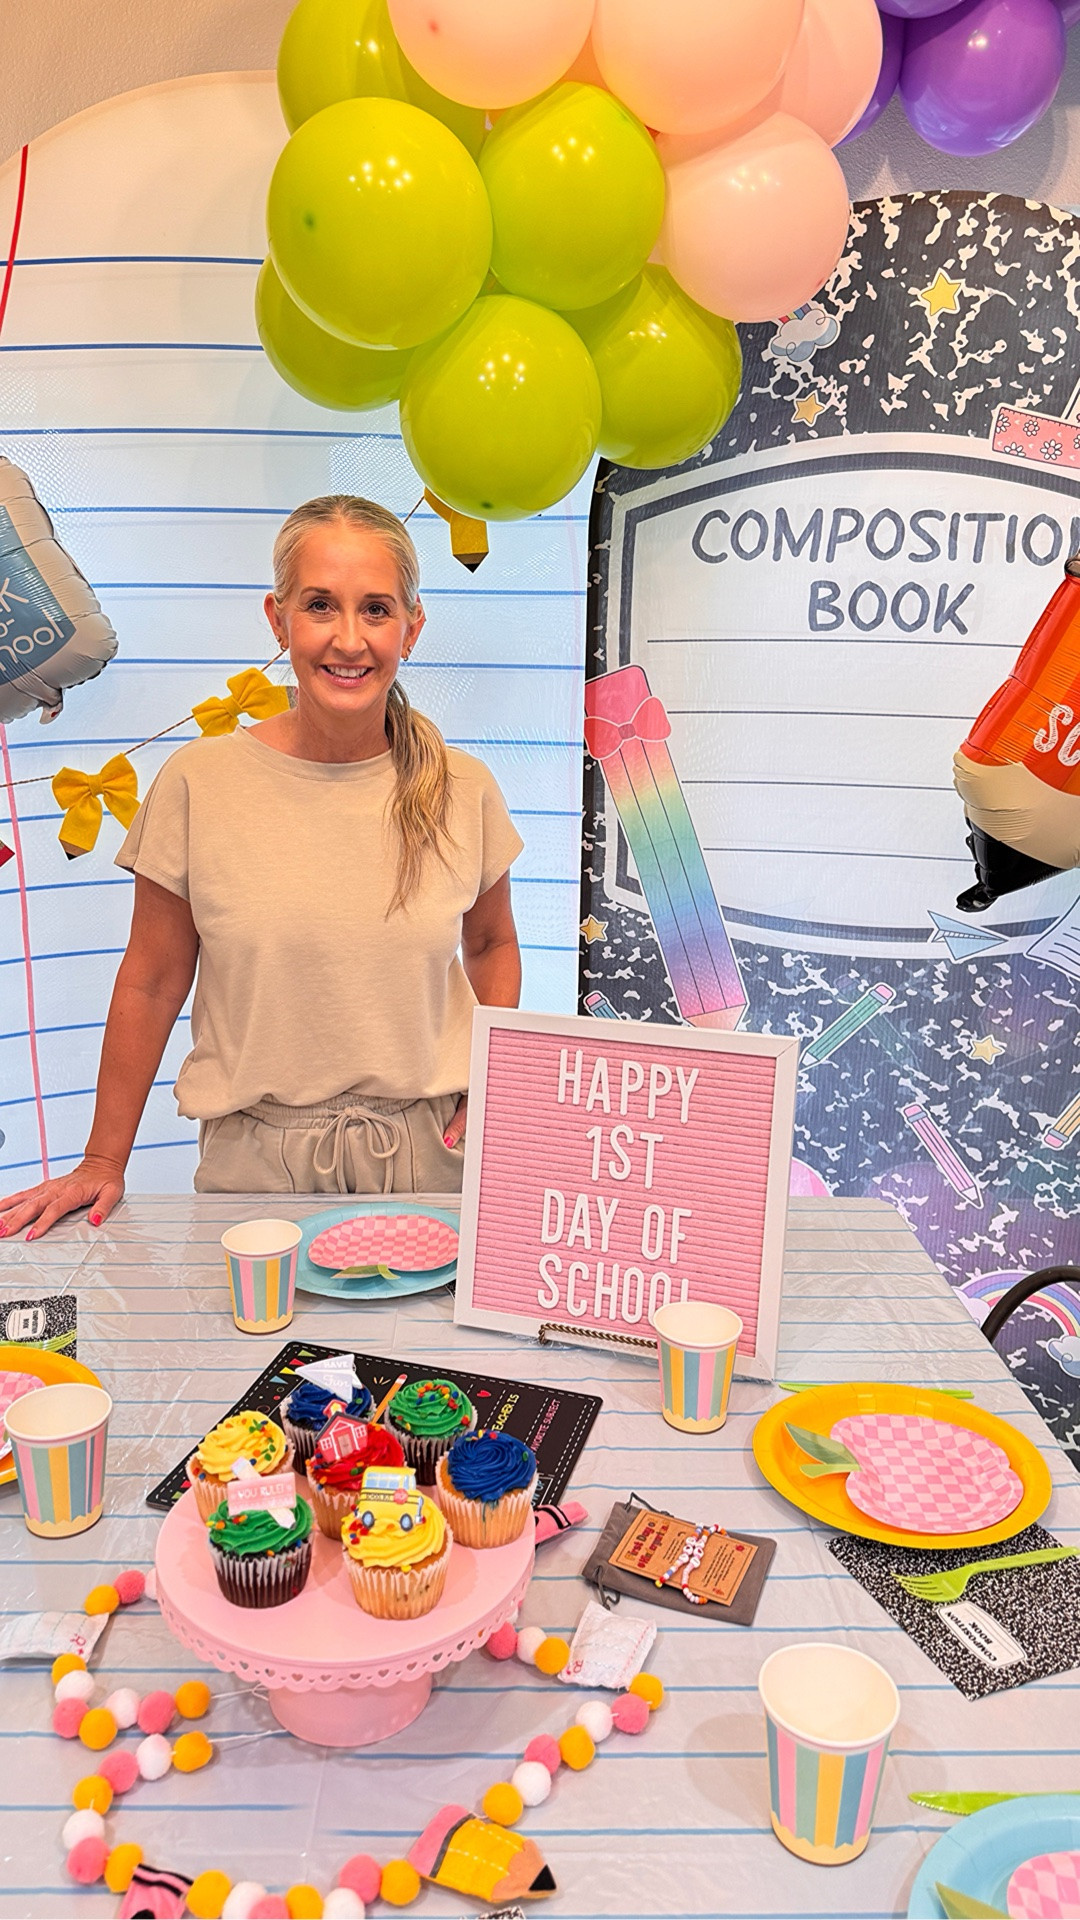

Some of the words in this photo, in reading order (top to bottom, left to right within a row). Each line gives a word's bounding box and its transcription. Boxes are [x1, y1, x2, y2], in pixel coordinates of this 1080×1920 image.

[808, 580, 975, 635] BOOK
[557, 1048, 700, 1124] HAPPY
[585, 1124, 664, 1190] 1ST
[540, 1188, 619, 1253] DAY
[640, 1203, 692, 1264] OF
[507, 1393, 520, 1404] IS
[530, 1424, 547, 1453] AVORITE
[543, 1399, 560, 1424] SUBJECT
[945, 1611, 998, 1662] COMPOSITION
[968, 1621, 993, 1645] BOOK
